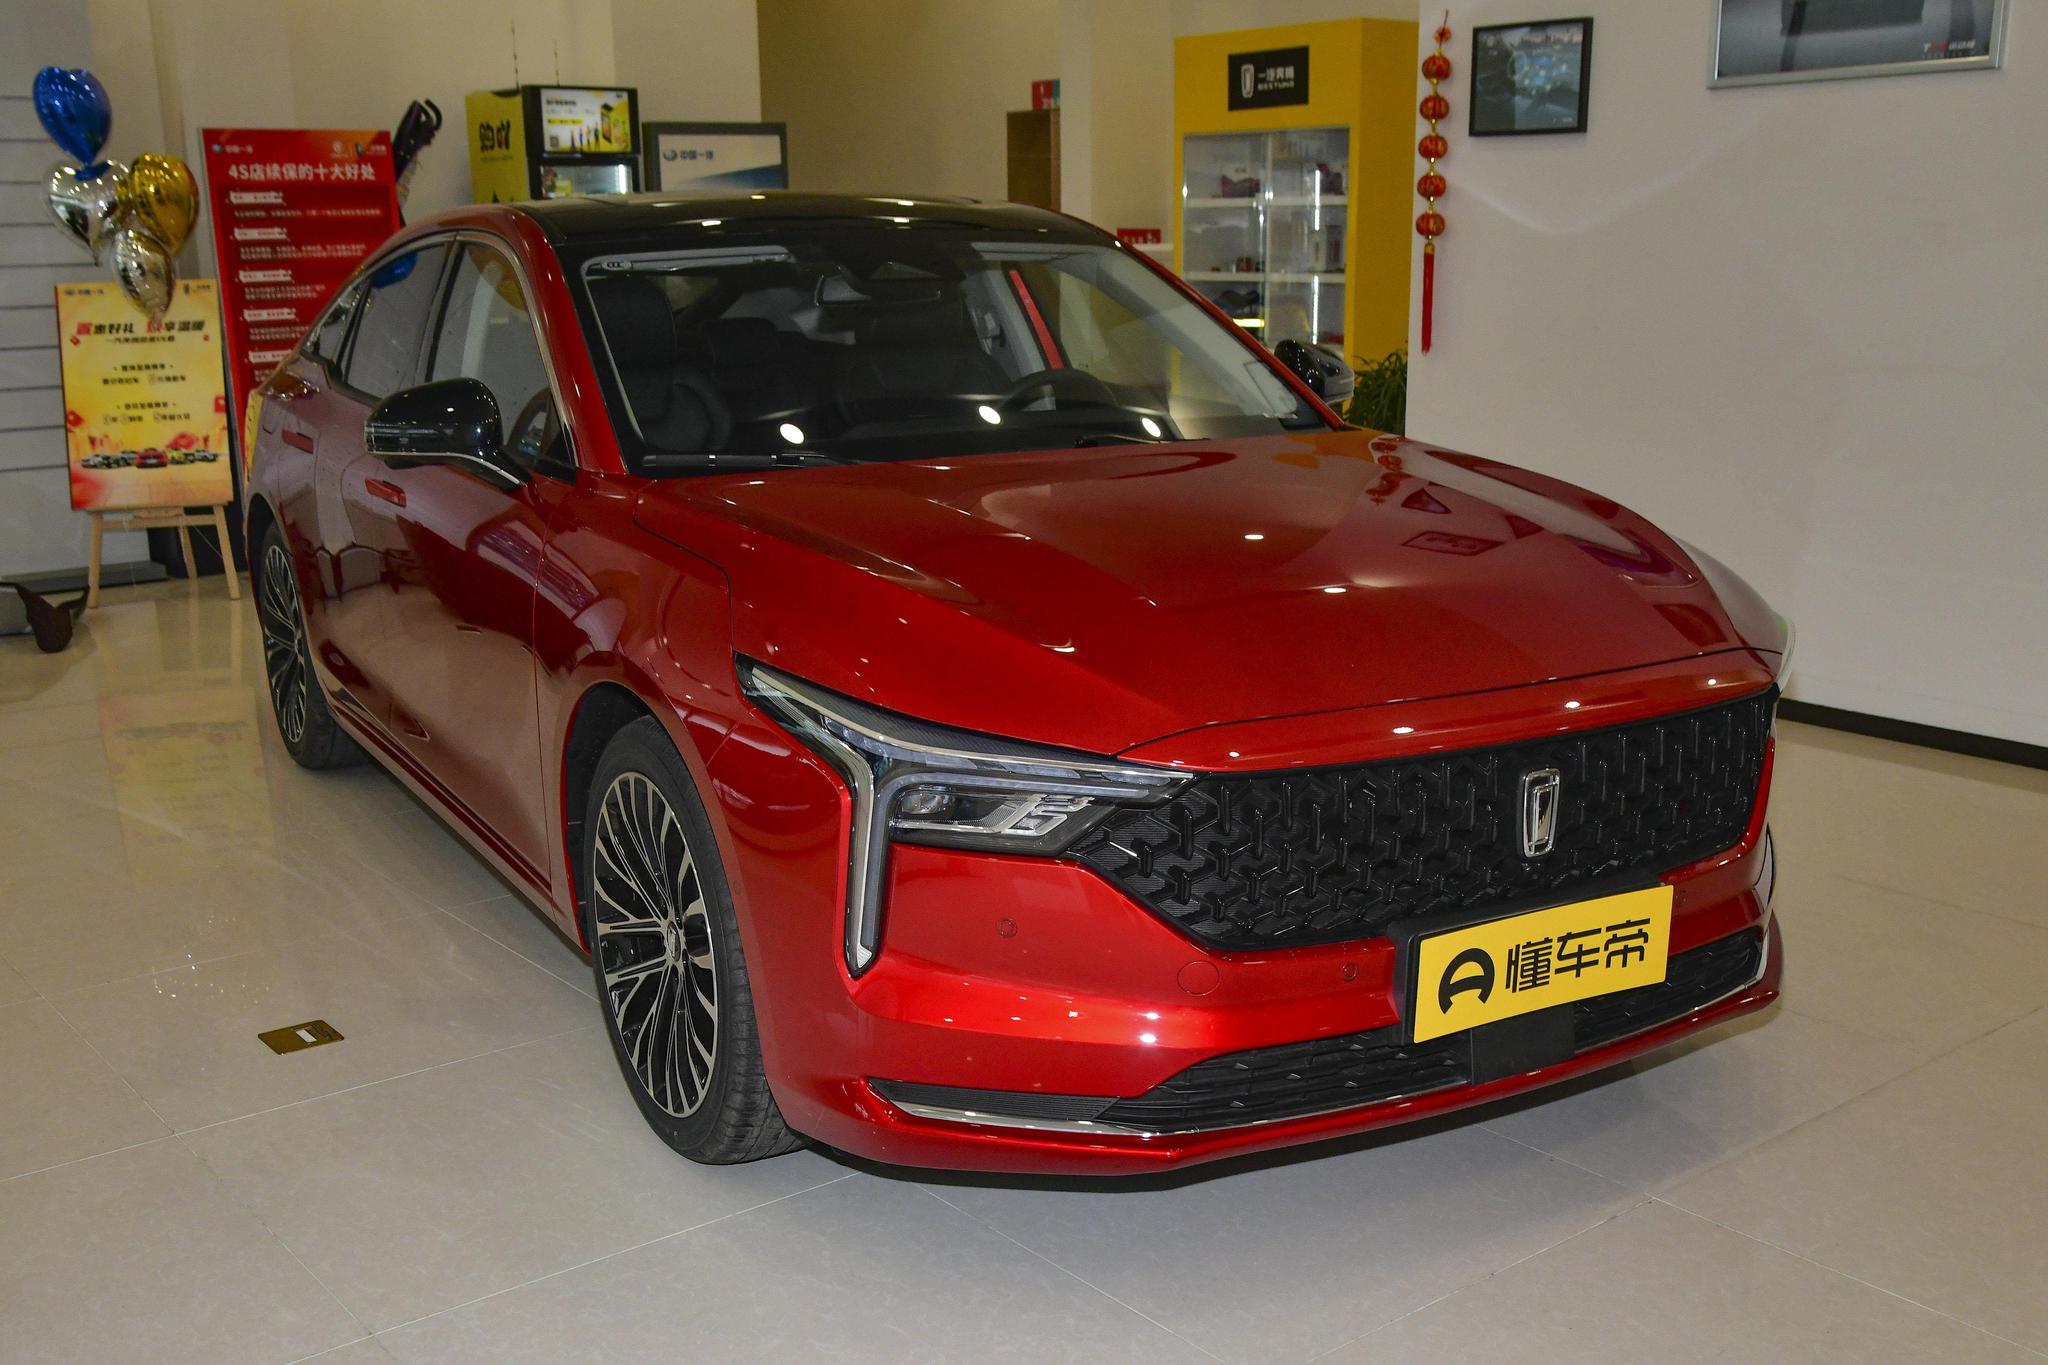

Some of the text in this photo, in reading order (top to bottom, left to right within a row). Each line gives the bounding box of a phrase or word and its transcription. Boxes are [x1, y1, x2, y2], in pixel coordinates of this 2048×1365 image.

[1257, 65, 1295, 80] 一汽奔腾
[227, 162, 376, 181] 4S店续保的十大好处
[1505, 918, 1651, 994] 懂车帝
